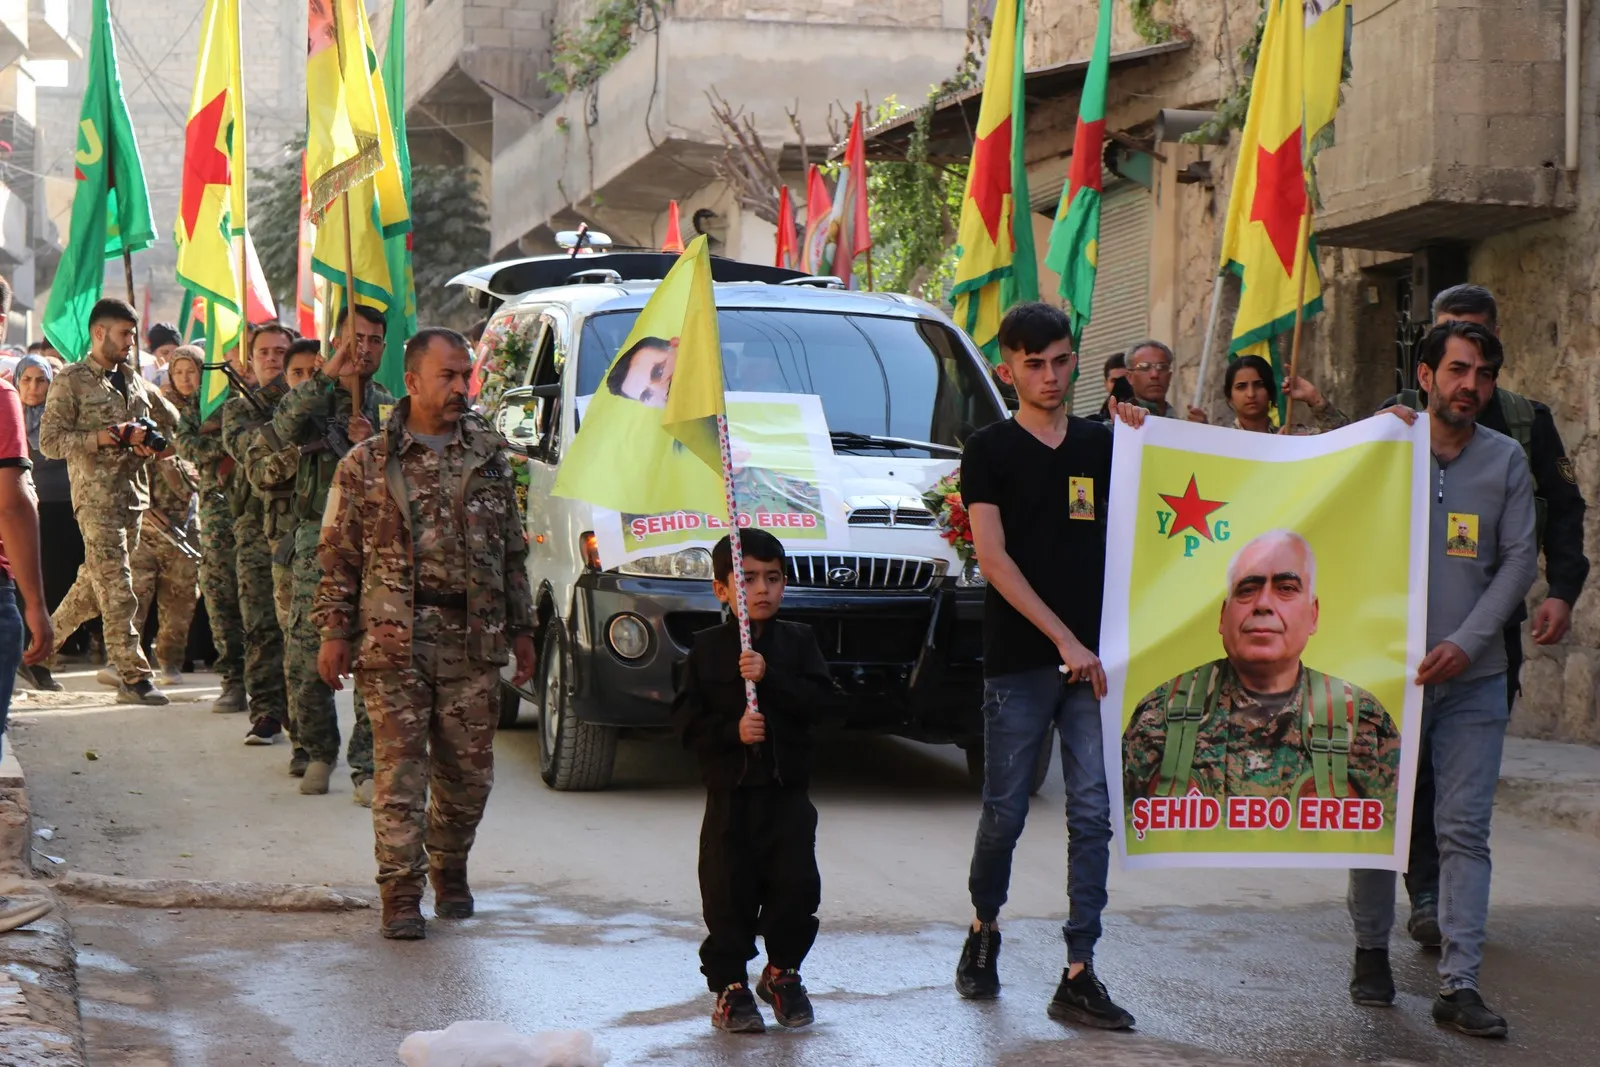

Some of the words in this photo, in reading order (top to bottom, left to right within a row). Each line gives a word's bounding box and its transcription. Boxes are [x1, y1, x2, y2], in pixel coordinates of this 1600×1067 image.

[632, 511, 700, 541] ŞEHÎD
[706, 514, 752, 528] EO
[757, 513, 816, 528] EREB
[1133, 788, 1219, 839] ŞEHÎD
[1228, 796, 1290, 830] EBO
[1299, 798, 1383, 830] EREB
